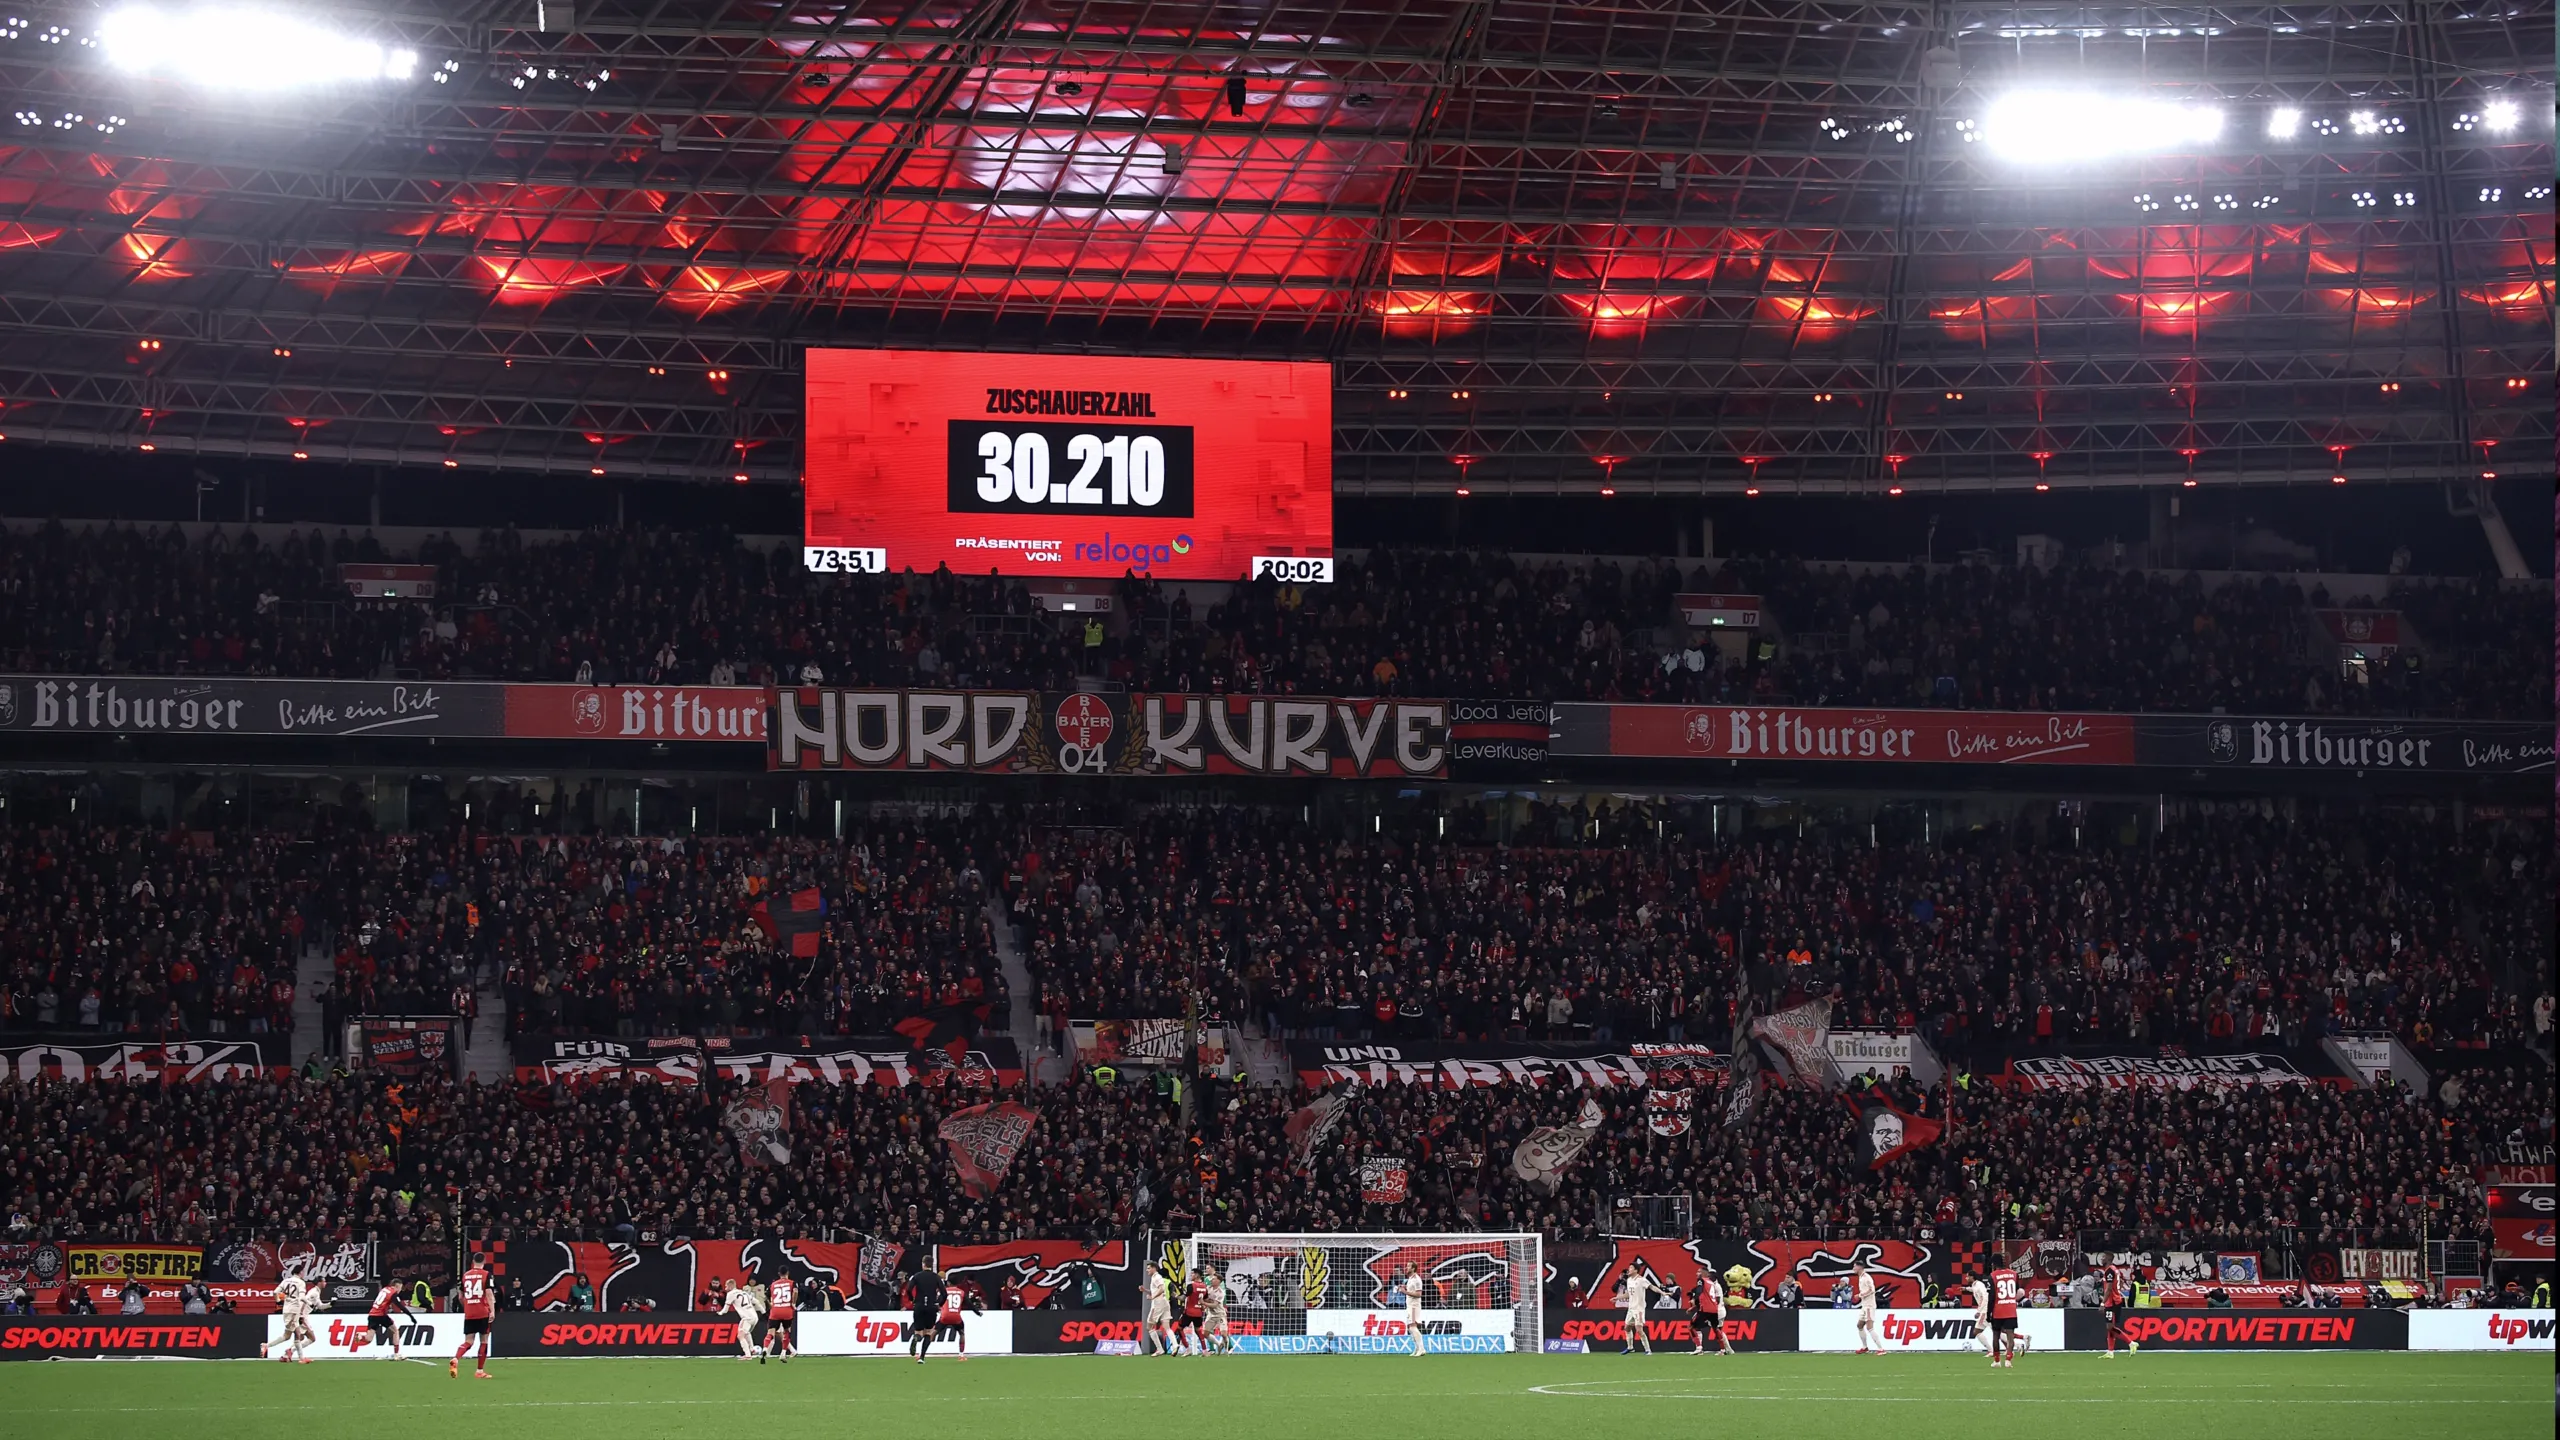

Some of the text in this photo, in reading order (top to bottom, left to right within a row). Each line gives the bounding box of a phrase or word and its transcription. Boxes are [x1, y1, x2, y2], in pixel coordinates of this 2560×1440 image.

[986, 388, 1156, 418] ZUSCHAUERZAHL
[976, 431, 1165, 506] 30.210
[955, 537, 1062, 551] PRÄSENTIERT
[1075, 533, 1170, 571] reloga
[812, 550, 876, 570] 73:51
[1024, 551, 1062, 562] VON:
[31, 681, 245, 730] Bitburger
[279, 686, 440, 730] Bitte ein Bit
[1451, 704, 1498, 720] Jood
[778, 690, 1030, 767] NORD
[1058, 715, 1111, 728] BAYER
[1079, 696, 1091, 749] BAYER
[1146, 697, 1445, 774] KURVE
[1727, 710, 1915, 757] Bitburger
[1947, 717, 2090, 758] Bitte ein Bit
[2250, 720, 2432, 766] Bitburger
[1059, 743, 1108, 774] 04
[1454, 742, 1548, 761] Leverkusen
[2463, 739, 2513, 768] Bitte
[555, 1041, 630, 1057] FÜR
[1324, 1044, 1401, 1062] UND
[1833, 1040, 1908, 1057] Bitburger
[2342, 1250, 2418, 1279] LEV ELITE
[285, 1283, 297, 1298] 42
[464, 1279, 484, 1299] 34
[773, 1286, 791, 1304] 25
[1997, 1281, 2016, 1299] 30
[947, 1295, 961, 1308] 19
[1, 1326, 221, 1348] SPORTWETTEN
[1883, 1314, 1978, 1345] tipwin
[2124, 1317, 2355, 1342] SPORTWETTEN
[2488, 1313, 2556, 1345] tipw
[1259, 1336, 1330, 1351] NIEDAX
[1338, 1336, 1412, 1351] NIEDAX
[1427, 1336, 1501, 1351] NIEDAX
